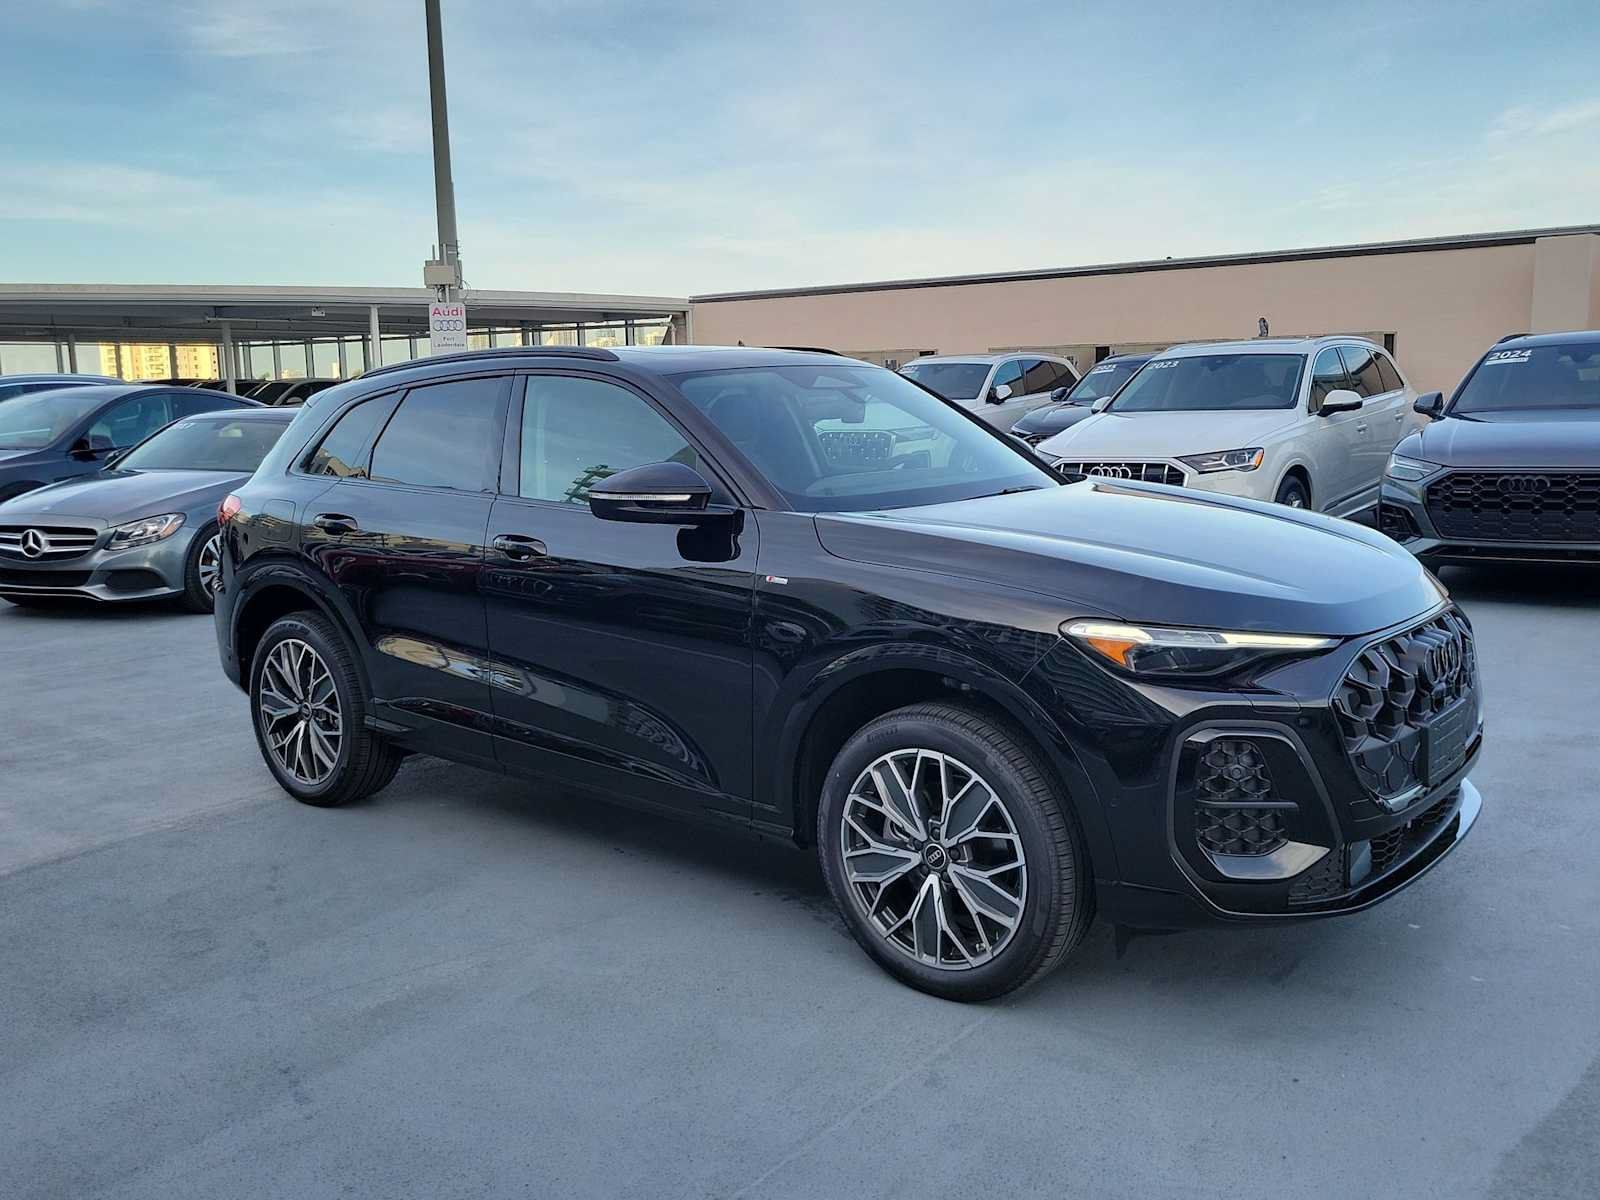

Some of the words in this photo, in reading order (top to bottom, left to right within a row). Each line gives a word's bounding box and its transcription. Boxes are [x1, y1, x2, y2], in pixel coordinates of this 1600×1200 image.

[432, 307, 463, 316] Audi
[1491, 350, 1532, 359] 2024
[1148, 361, 1180, 369] 2023
